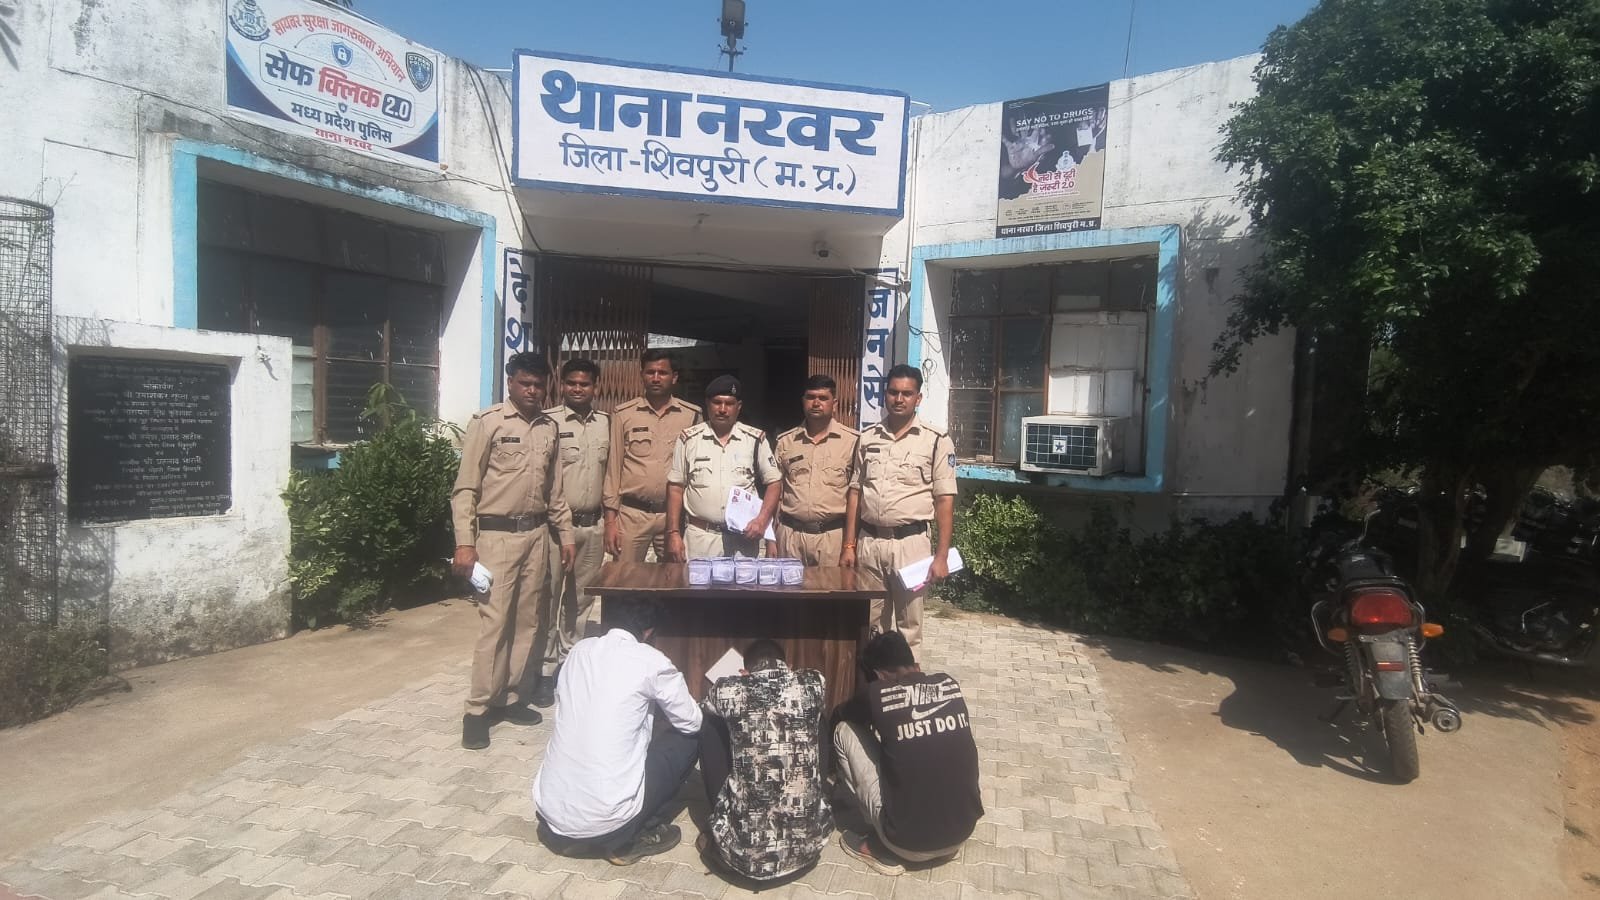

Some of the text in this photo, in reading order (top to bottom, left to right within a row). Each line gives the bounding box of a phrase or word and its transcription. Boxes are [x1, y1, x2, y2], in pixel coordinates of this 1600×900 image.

[272, 15, 301, 36] सायबर
[302, 14, 329, 32] सुरक्षा
[375, 46, 406, 82] अभियान
[265, 50, 410, 119] सेफ क्लिक 2.0
[291, 102, 392, 143] मध्य प्रदेश पुलिस
[540, 69, 884, 156] थाना नरवर
[1016, 117, 1033, 127] SAY
[1034, 115, 1047, 124] NO
[1049, 113, 1061, 121] TO
[1063, 107, 1095, 120] DRUGS
[315, 128, 373, 151] थाना नरवर
[897, 678, 961, 709] NIKE
[897, 719, 932, 741] JUST
[935, 715, 957, 733] DO
